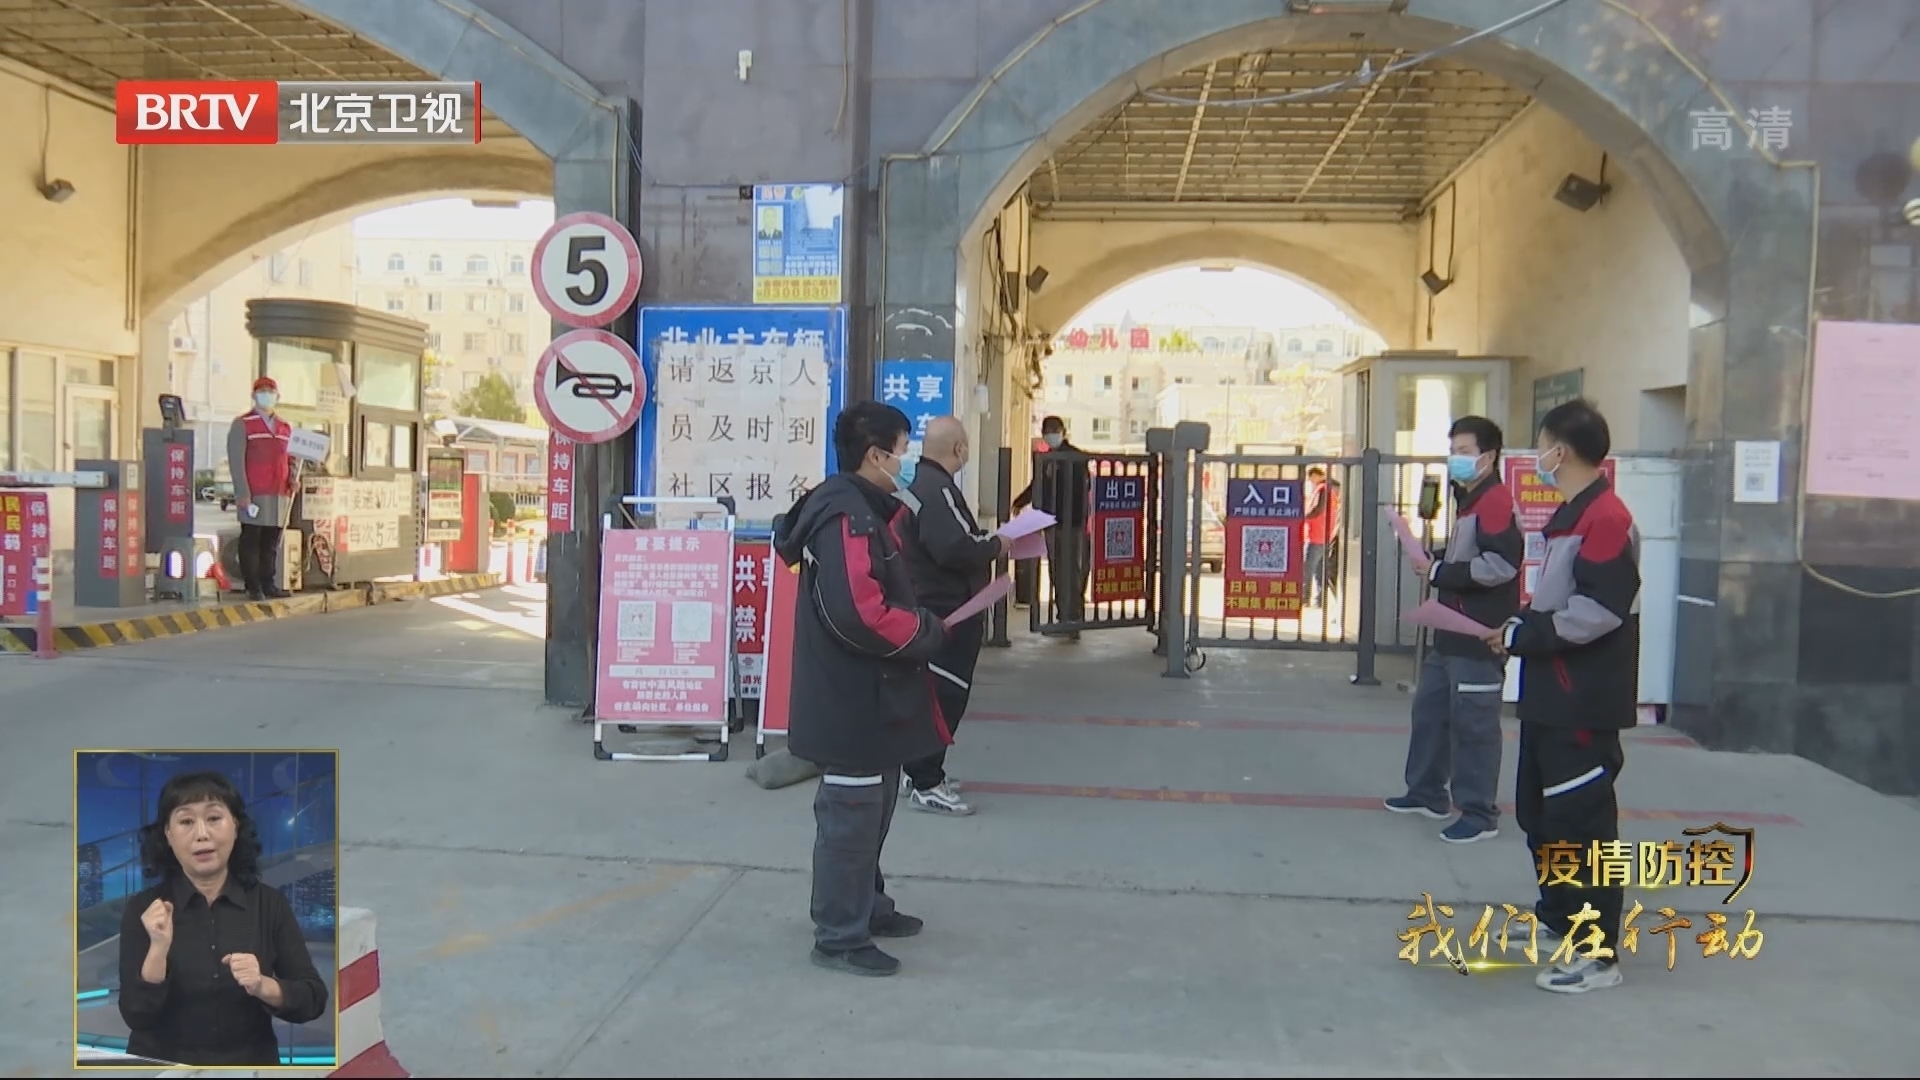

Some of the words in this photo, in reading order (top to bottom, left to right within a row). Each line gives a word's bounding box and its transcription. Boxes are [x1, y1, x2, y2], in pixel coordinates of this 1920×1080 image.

[565, 235, 609, 306] 5
[1069, 328, 1149, 348] 幼儿园
[668, 355, 816, 386] 请返京人
[883, 373, 943, 402] 共享
[671, 414, 815, 446] 员及时到
[171, 449, 185, 514] 保持车距
[668, 471, 811, 503] 社区报备
[1106, 480, 1135, 499] 出口
[1243, 483, 1290, 504] 入口
[103, 499, 117, 569] 保持车距
[636, 536, 700, 552] 重要提示
[1230, 581, 1257, 594] 扫码
